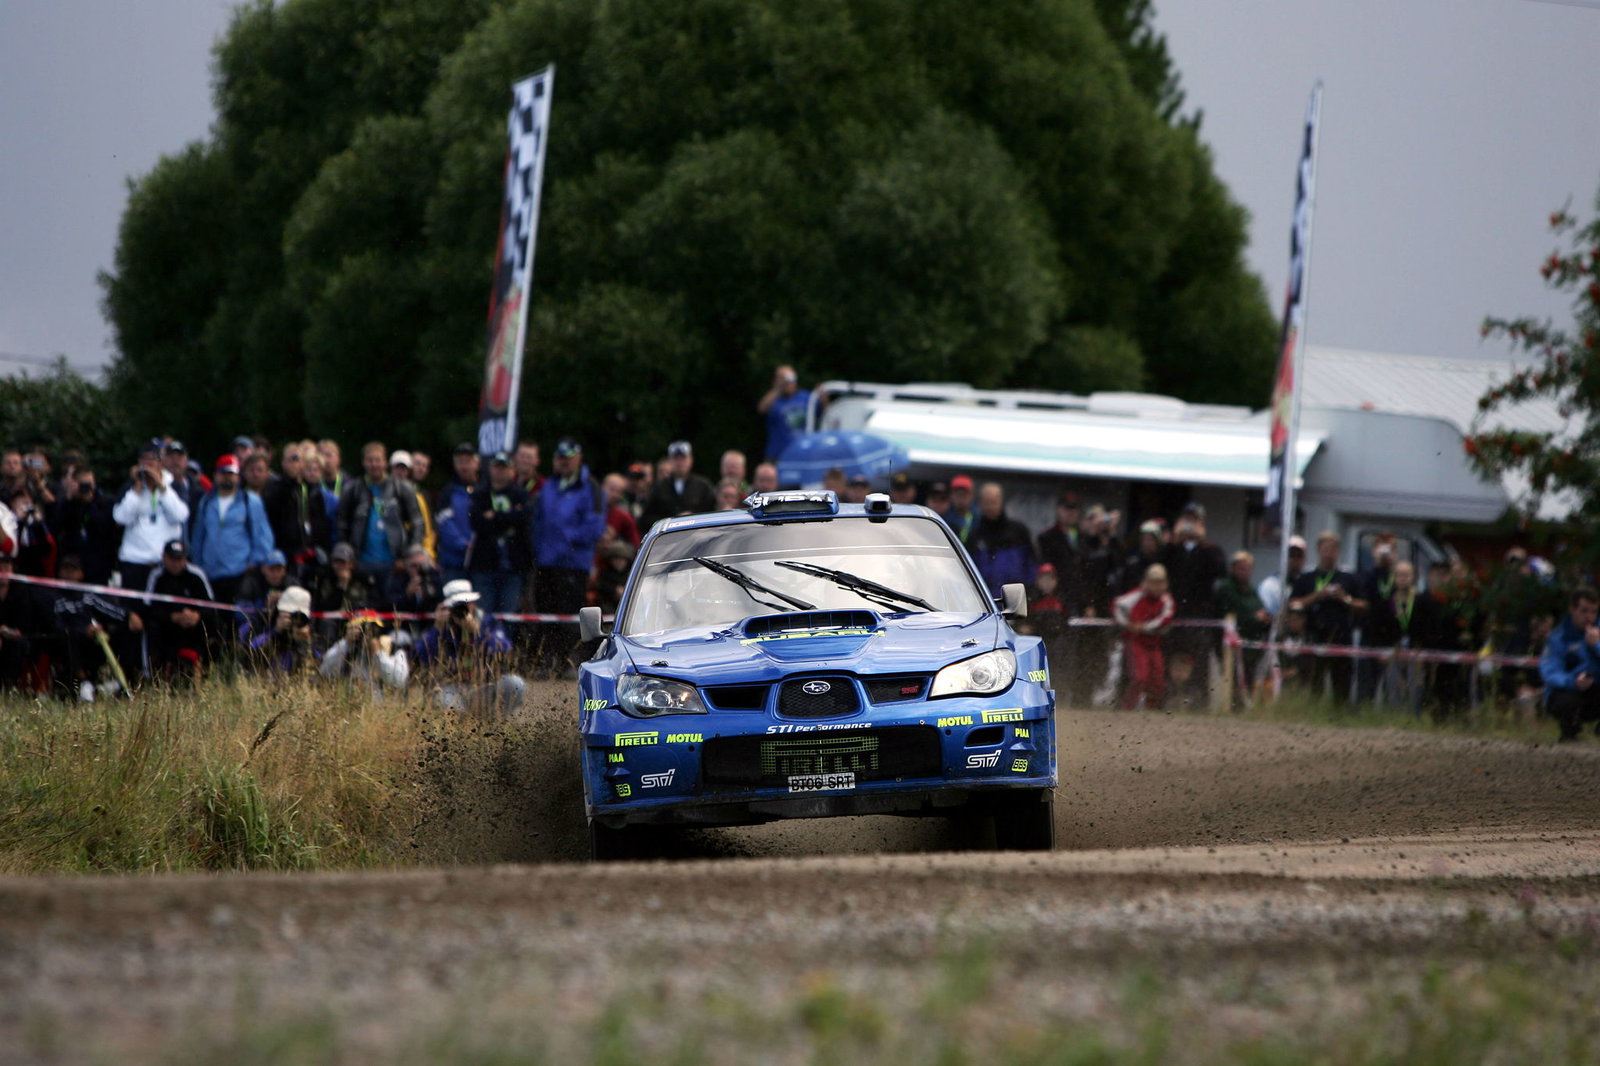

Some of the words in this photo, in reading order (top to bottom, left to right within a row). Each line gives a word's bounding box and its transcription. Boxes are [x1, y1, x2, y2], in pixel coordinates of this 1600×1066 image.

[584, 698, 608, 711] DENSO
[937, 715, 974, 728] MOTUL
[981, 708, 1024, 723] PIRELLI
[766, 724, 794, 734] STI
[1015, 728, 1029, 738] PIAA
[615, 731, 659, 747] PIRELLI
[666, 733, 703, 744] MOTUL
[760, 736, 879, 775] PIRELLI
[1012, 759, 1028, 772] BBS
[828, 775, 853, 789] SRT
